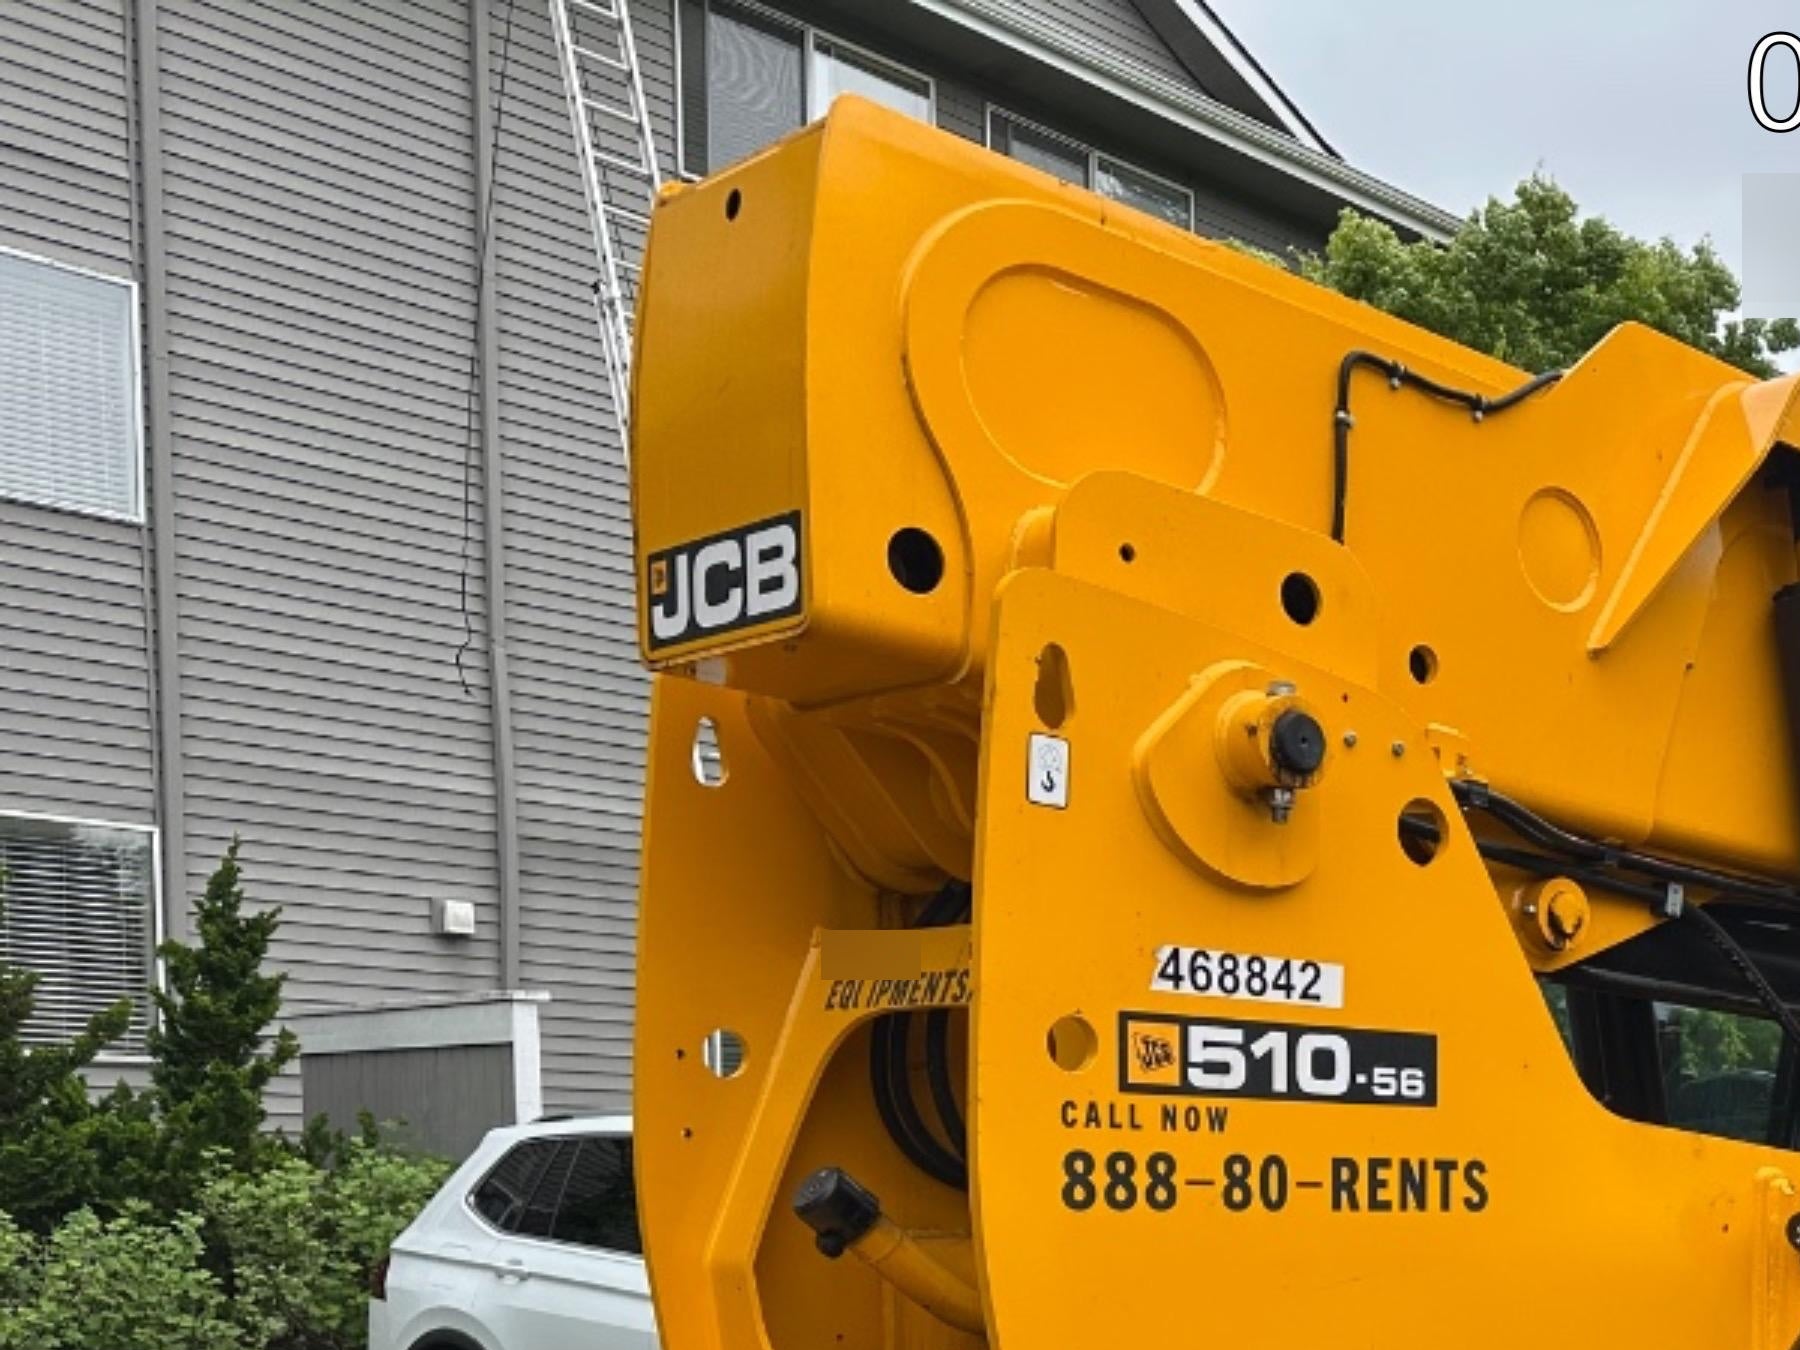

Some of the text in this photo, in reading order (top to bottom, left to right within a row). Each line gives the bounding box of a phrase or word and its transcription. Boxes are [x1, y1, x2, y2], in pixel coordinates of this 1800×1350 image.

[652, 524, 799, 640] JCB
[825, 968, 972, 1011] EQUIPMENTS
[1158, 947, 1322, 1001] 468842
[1061, 1101, 1228, 1132] CALL NOW
[1061, 1149, 1490, 1213] 888-80-RENTS
